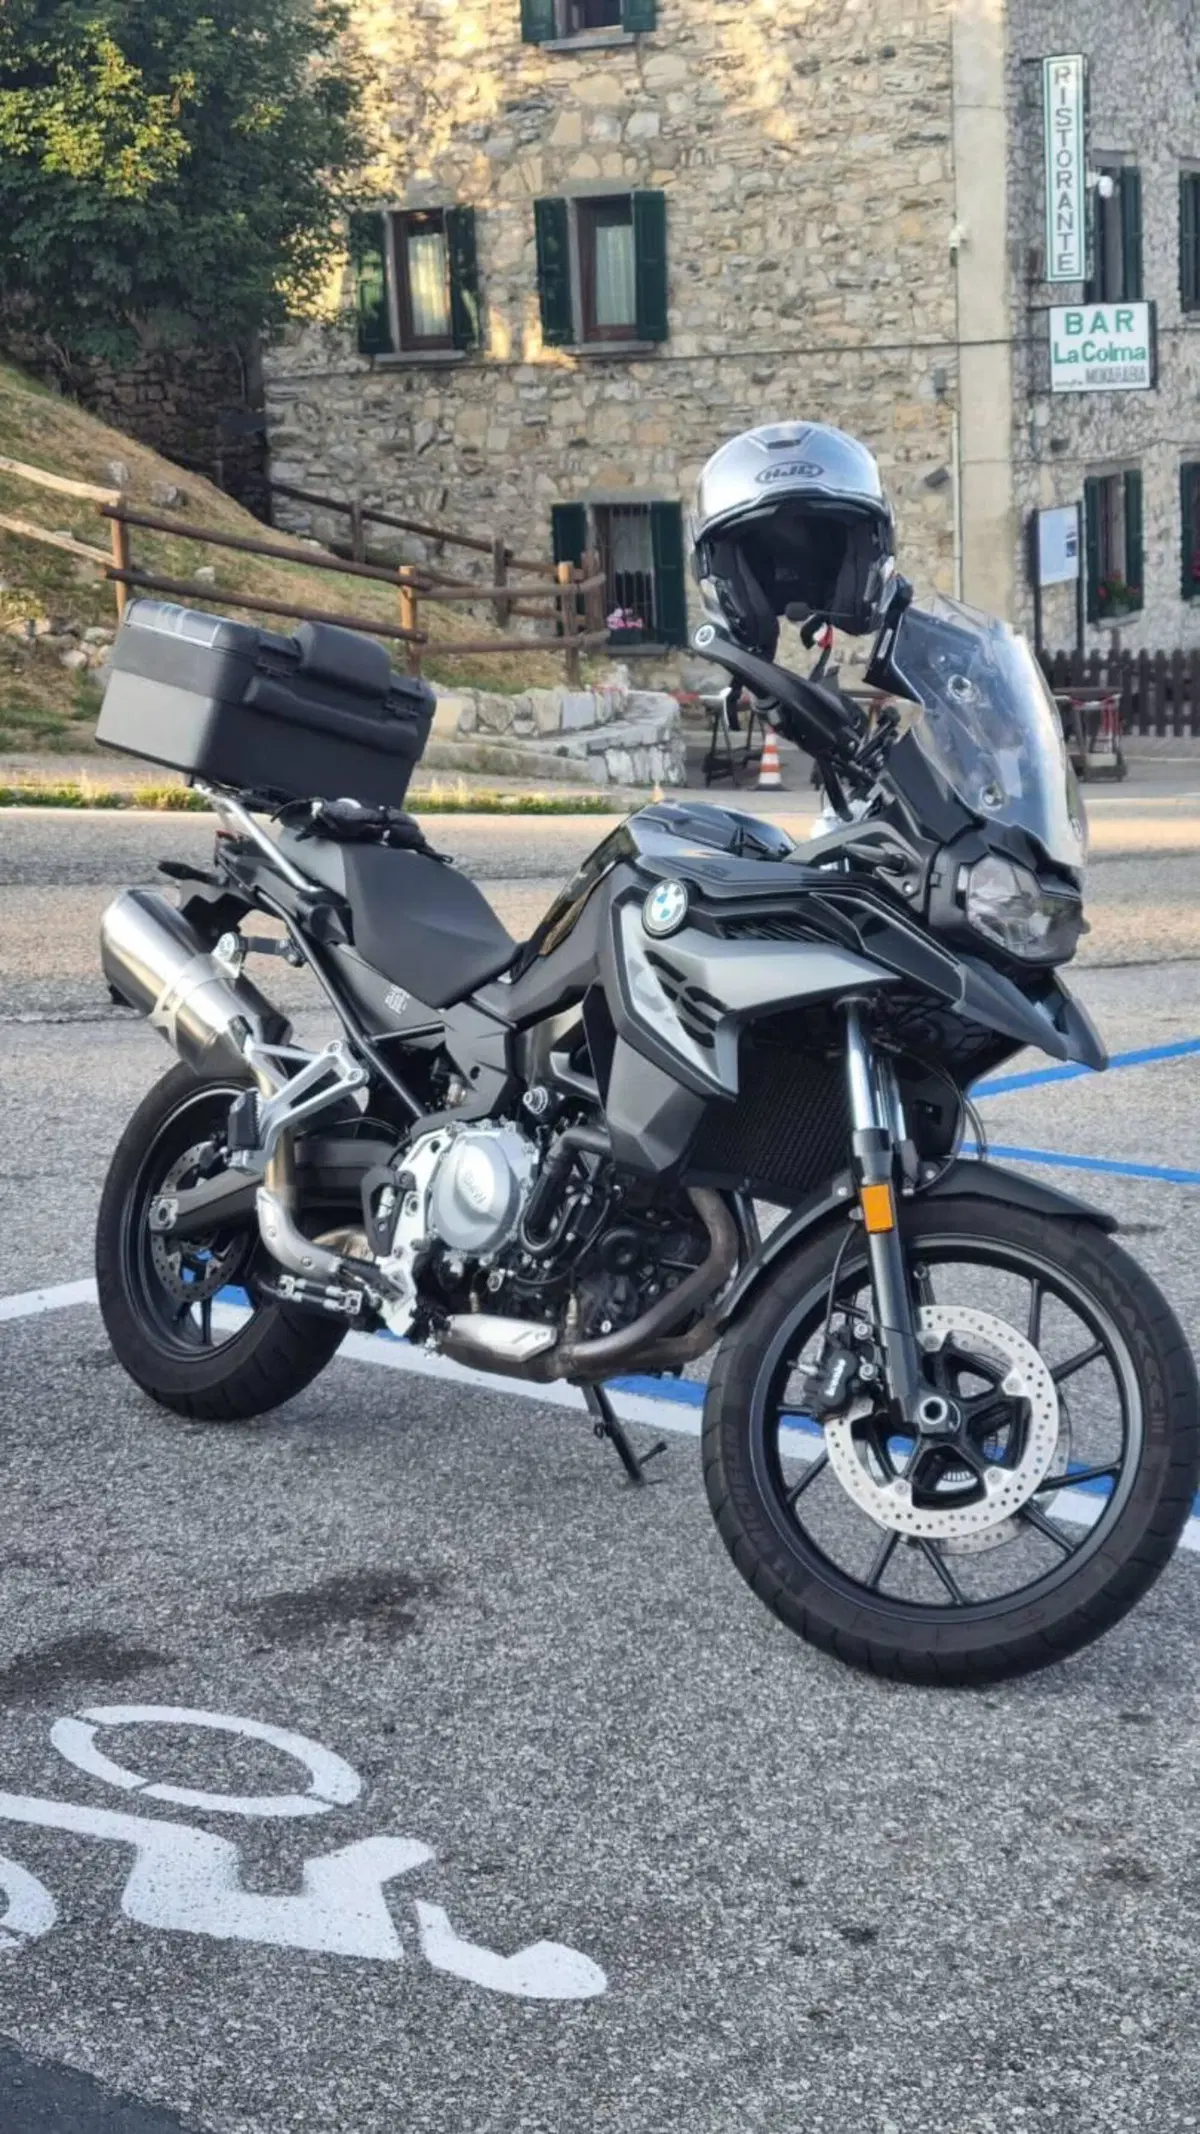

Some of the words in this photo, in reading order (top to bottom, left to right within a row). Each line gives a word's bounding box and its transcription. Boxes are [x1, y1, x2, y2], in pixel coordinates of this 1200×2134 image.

[1053, 66, 1075, 272] RISTORANTE
[1065, 309, 1134, 335] BAR
[764, 464, 814, 480] HJC
